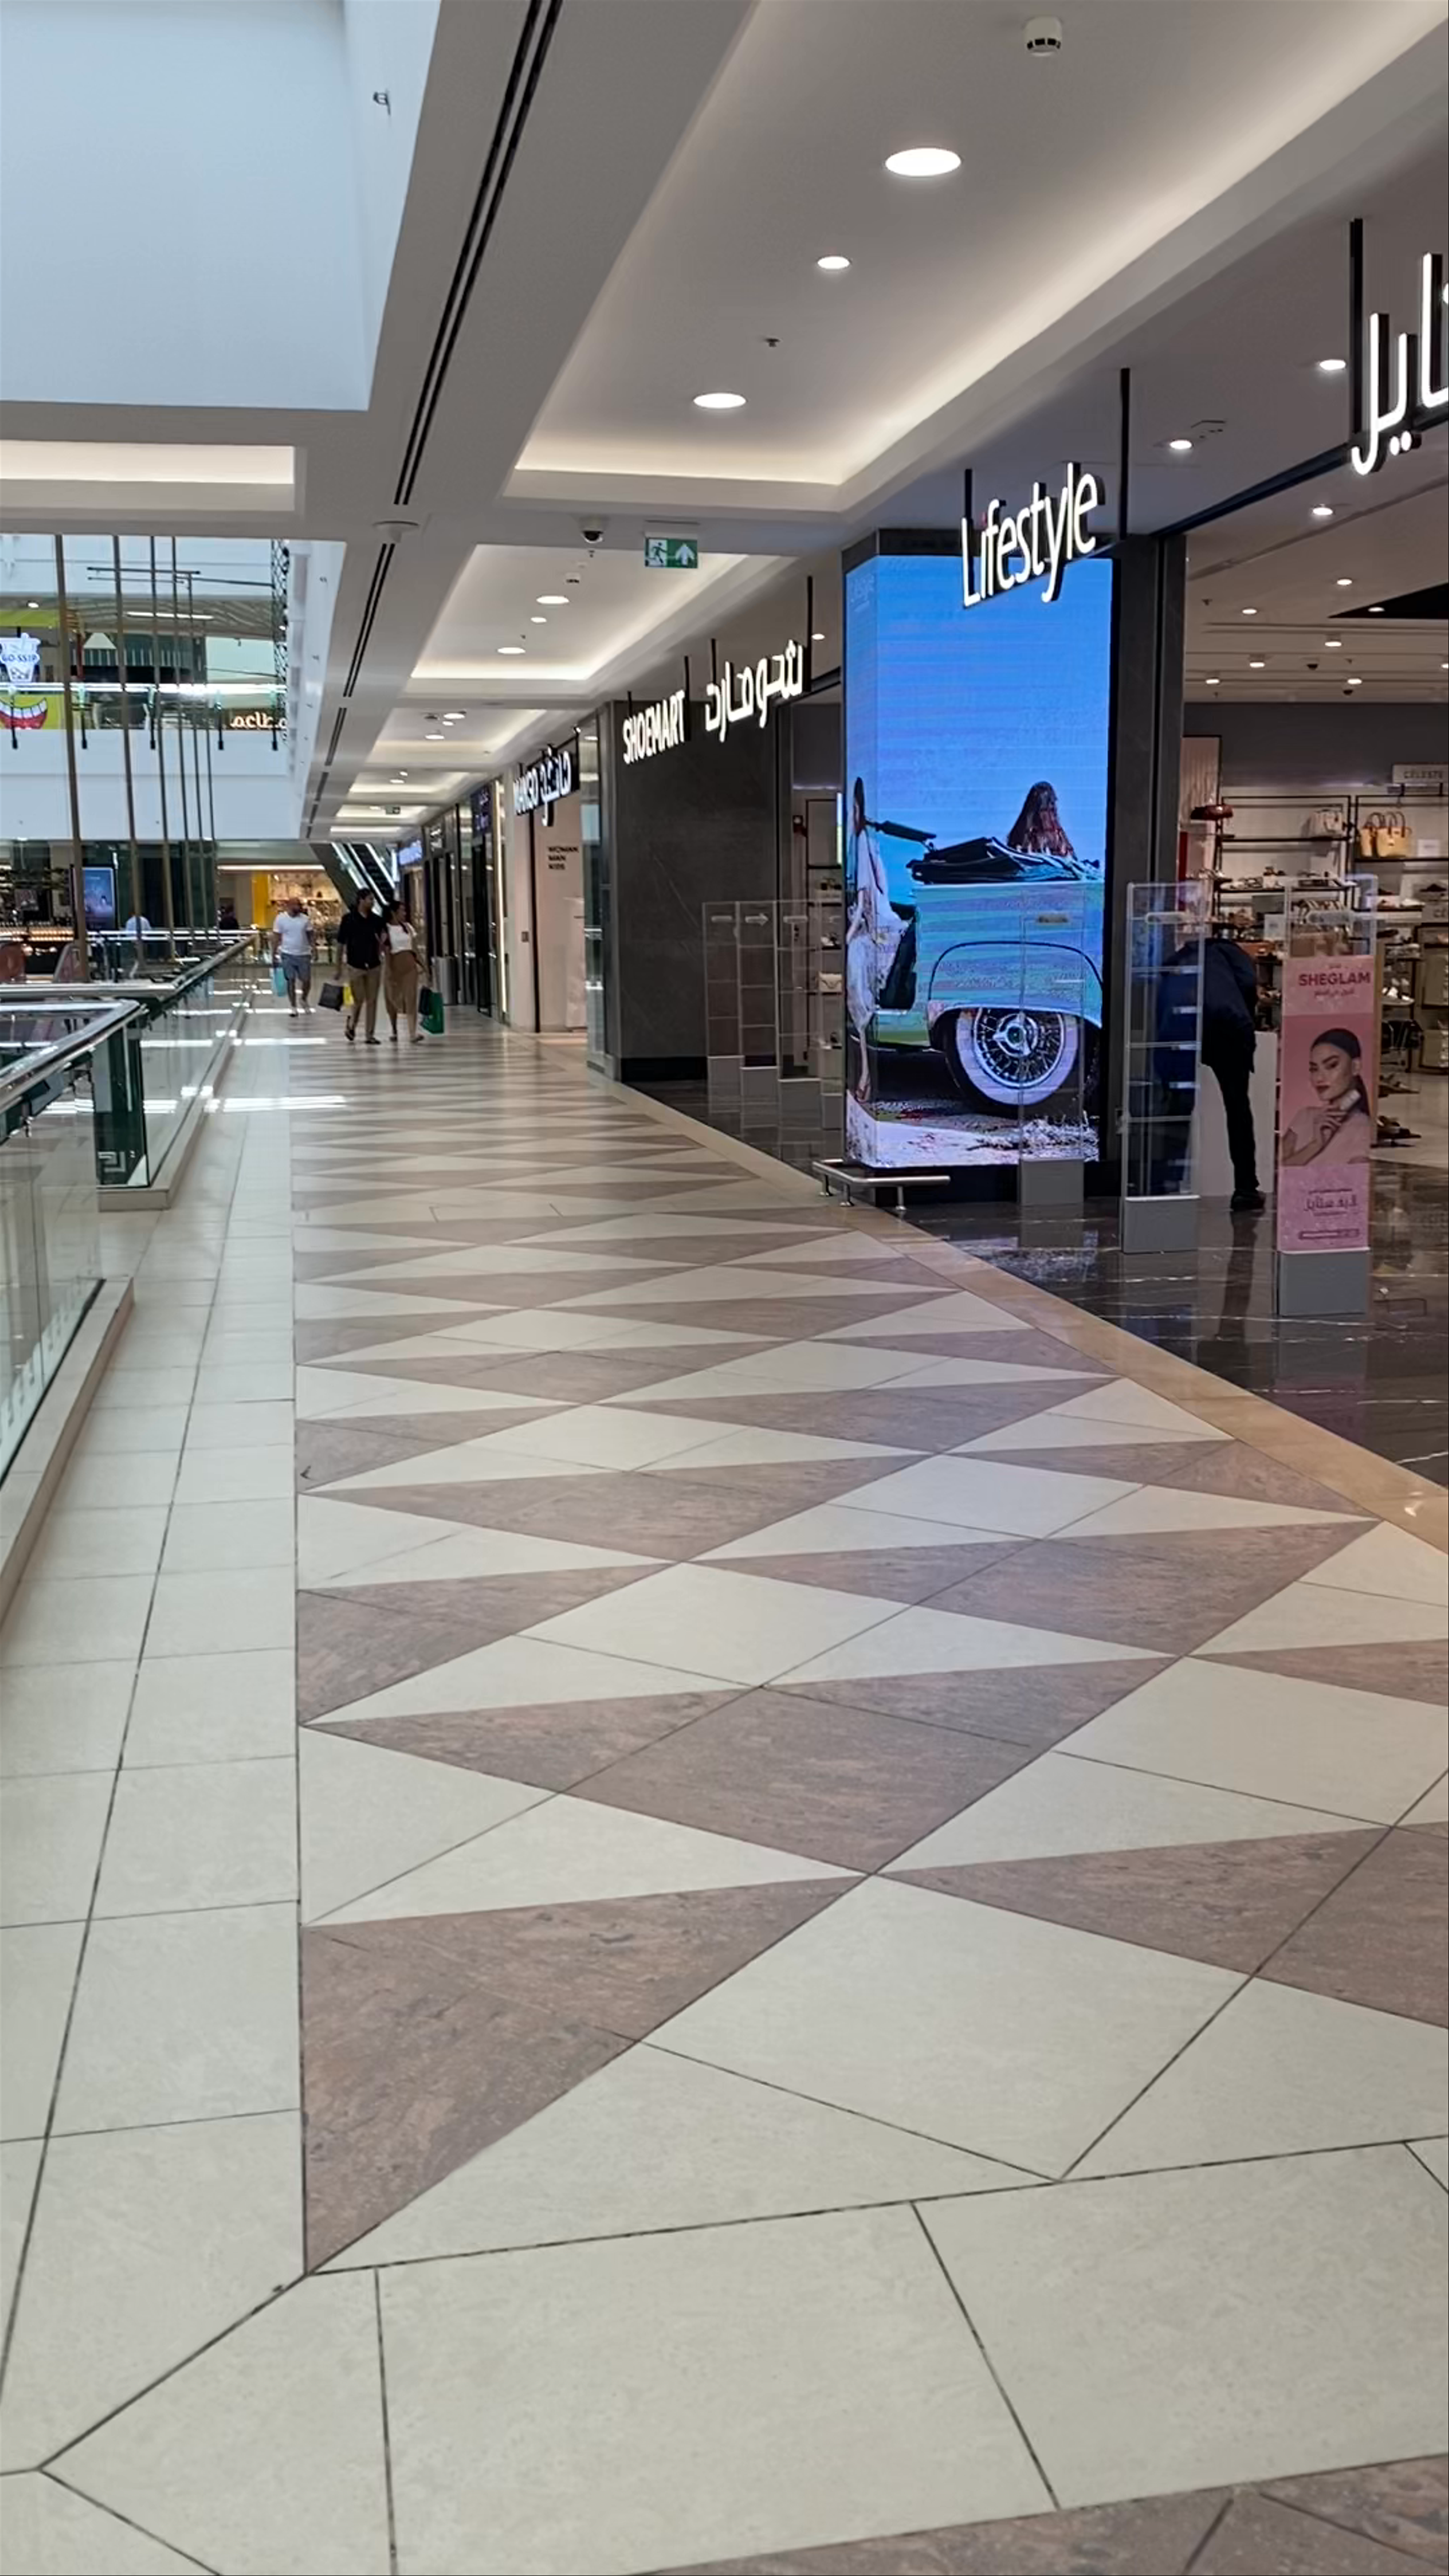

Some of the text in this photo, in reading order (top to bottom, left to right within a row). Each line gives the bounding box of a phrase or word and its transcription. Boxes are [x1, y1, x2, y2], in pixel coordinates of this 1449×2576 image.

[961, 462, 1098, 607] Lifestyle
[623, 689, 685, 764] SHOEMART
[1299, 972, 1371, 986] SHEGLAM
